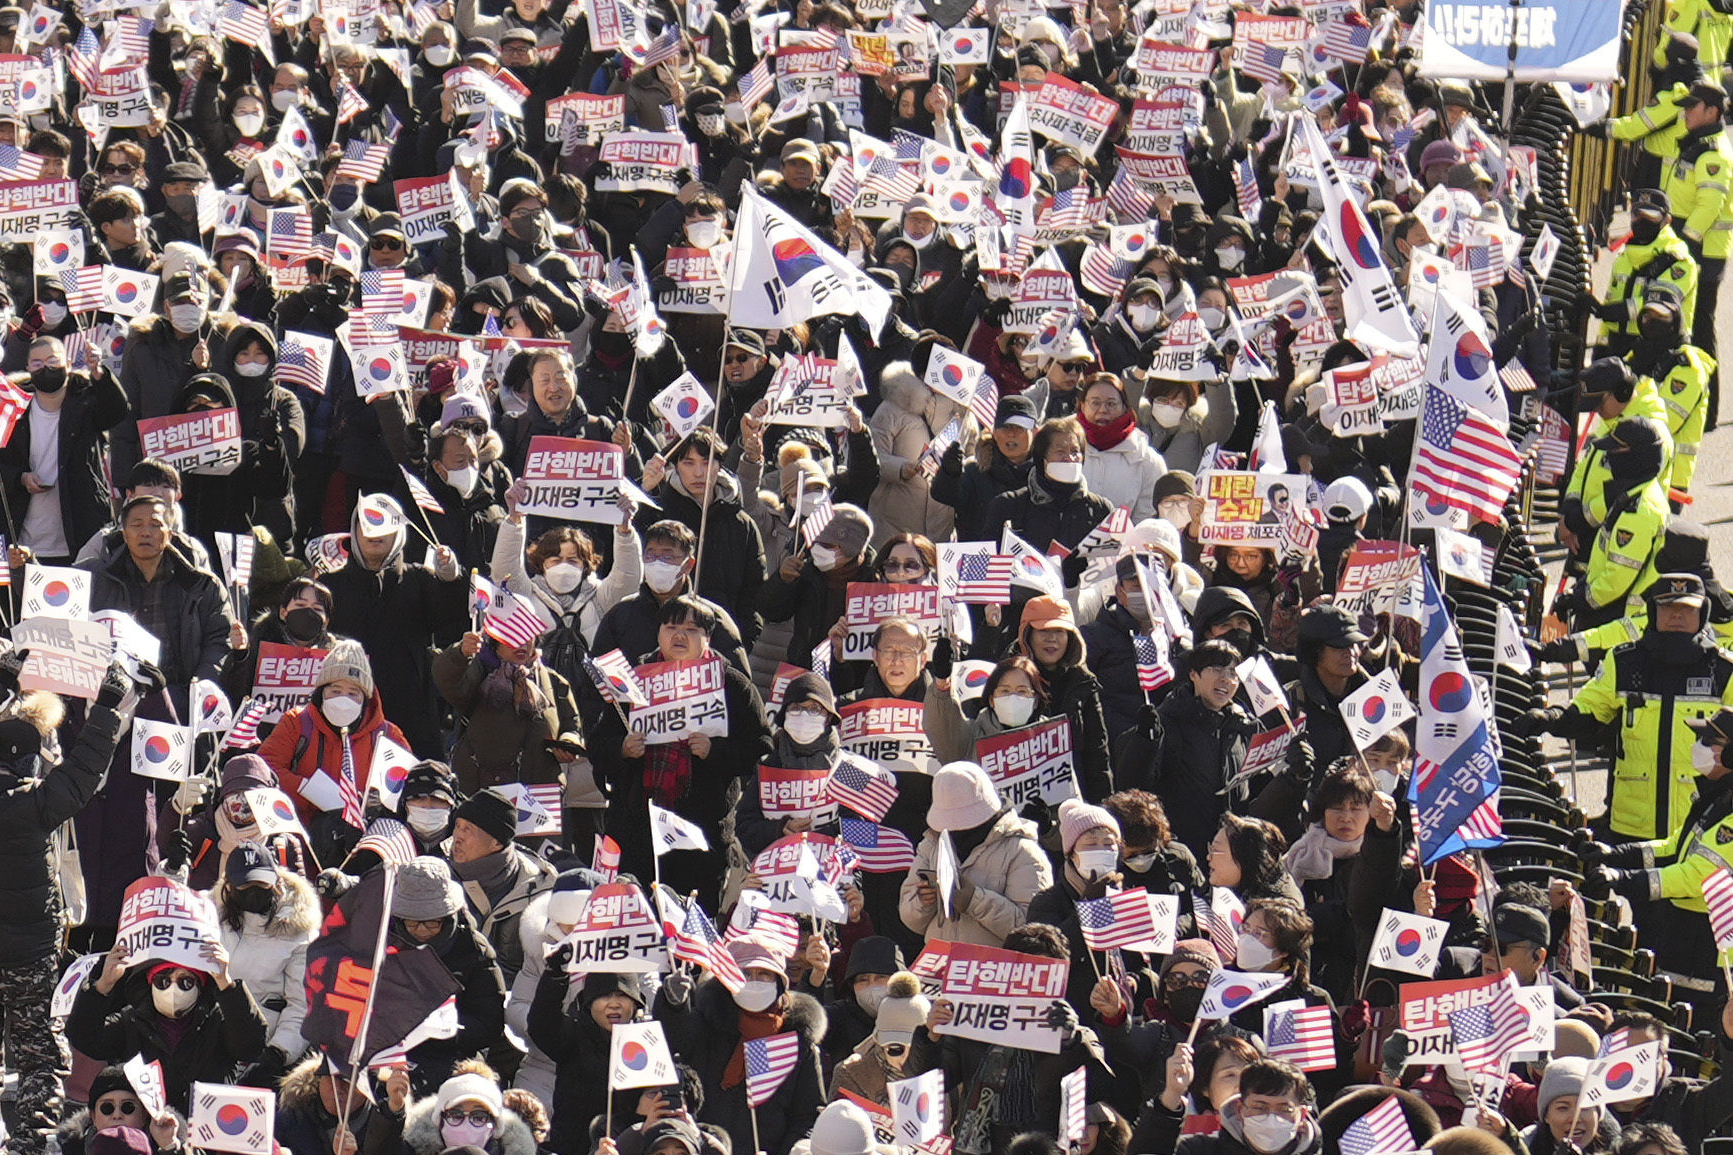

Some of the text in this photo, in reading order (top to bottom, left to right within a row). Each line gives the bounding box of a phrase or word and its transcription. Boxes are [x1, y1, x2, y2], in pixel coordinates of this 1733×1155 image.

[1157, 18, 1187, 34] 이재
[1236, 22, 1308, 41] 탄핵반대
[777, 52, 837, 74] 탄핵반대
[1138, 50, 1214, 72] 탄핵반대
[96, 67, 147, 96] 핵반대
[122, 98, 148, 114] 구속
[1040, 84, 1119, 121] 탄핵반대
[1132, 110, 1182, 129] 탄핵반
[602, 142, 681, 163] 탄핵반대
[666, 258, 718, 281] 탄핵반
[662, 287, 711, 306] 이재명
[1232, 285, 1268, 302] 탄핵
[1151, 352, 1195, 371] 이재명
[1337, 381, 1376, 406] 탄핵
[1341, 406, 1381, 430] 이재
[143, 412, 237, 458] 탄핵반대
[527, 450, 622, 480] 탄핵반대
[524, 485, 580, 508] 이재명
[1211, 475, 1256, 500] 내란
[1217, 501, 1262, 522] 수괴
[1201, 526, 1285, 542] 이재명 체포하
[848, 589, 939, 624] 탄핵반대
[633, 701, 726, 735] 이재명 구속
[842, 707, 923, 741] 탄핵반
[981, 721, 1070, 783] 탄핵반대
[761, 777, 830, 812] 탄핵반
[564, 936, 629, 965] 이재명
[947, 961, 1065, 996] 탄핵반대
[948, 1002, 1011, 1029] 이재명
[1406, 1035, 1454, 1056] 이재
